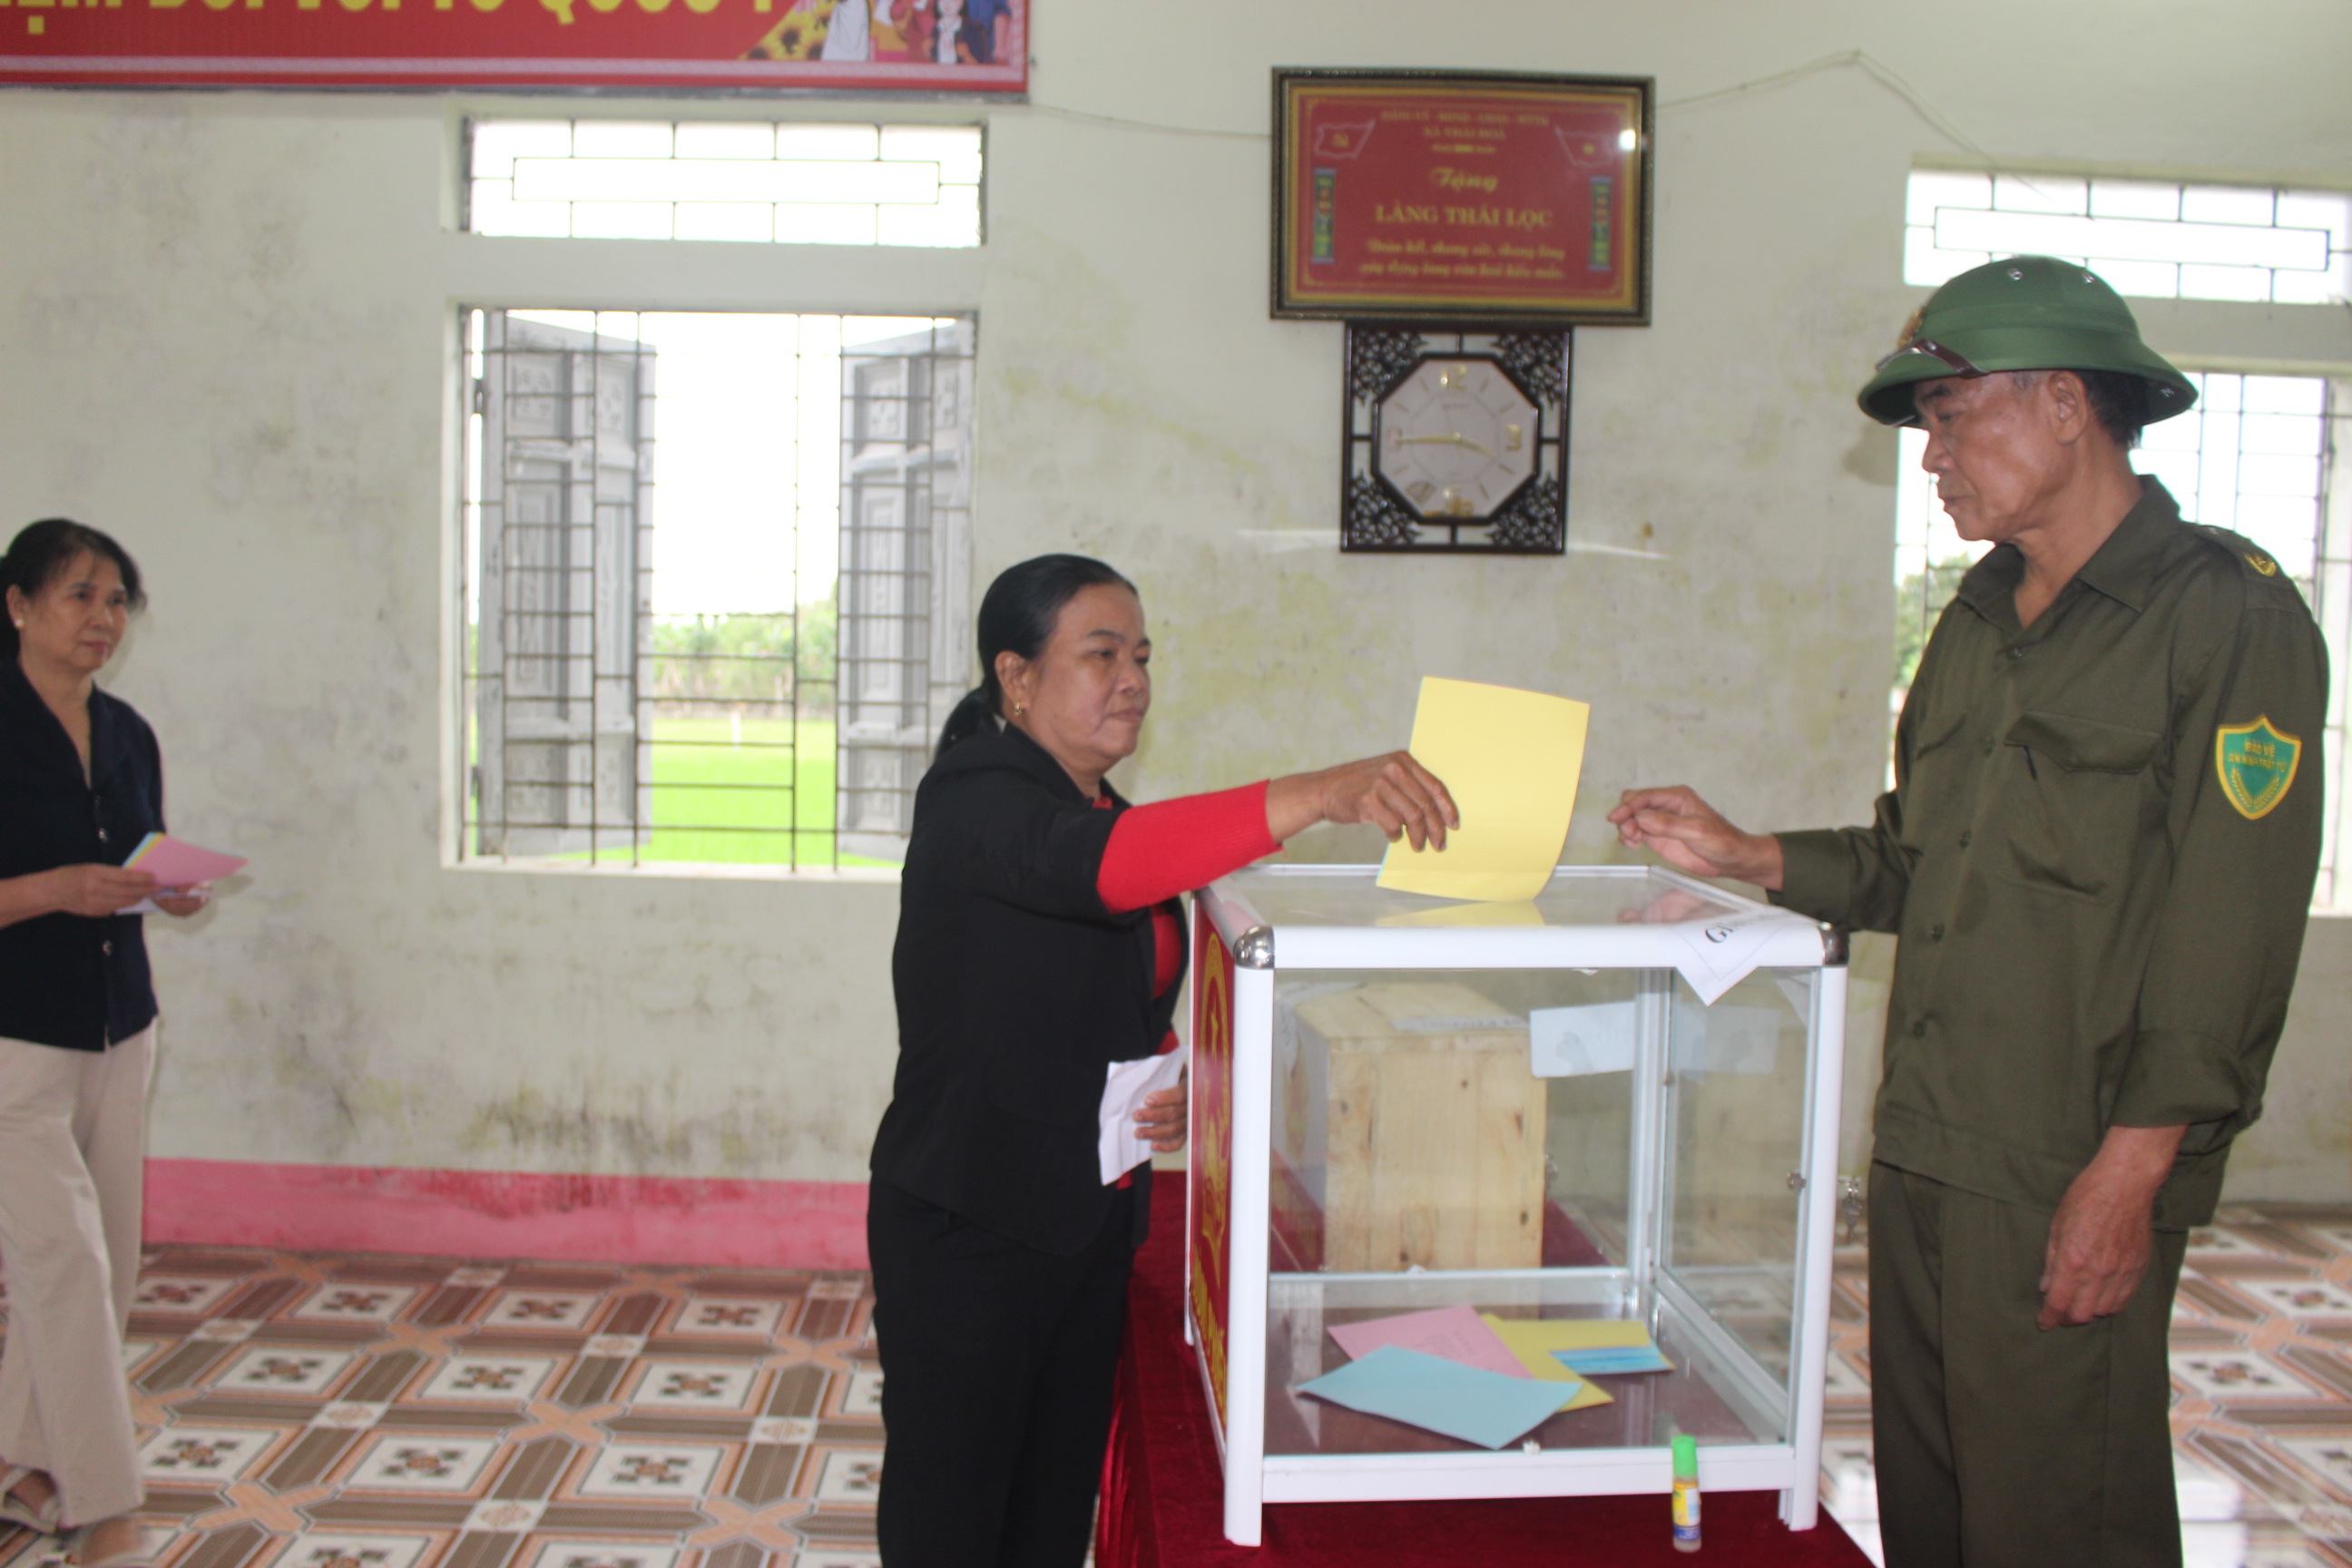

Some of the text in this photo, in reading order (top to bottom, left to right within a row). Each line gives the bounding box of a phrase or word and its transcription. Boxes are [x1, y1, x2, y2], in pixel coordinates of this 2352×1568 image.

[1444, 203, 1500, 225] THÁI
[1505, 208, 1553, 231] LỌC
[1441, 365, 1467, 391] 12
